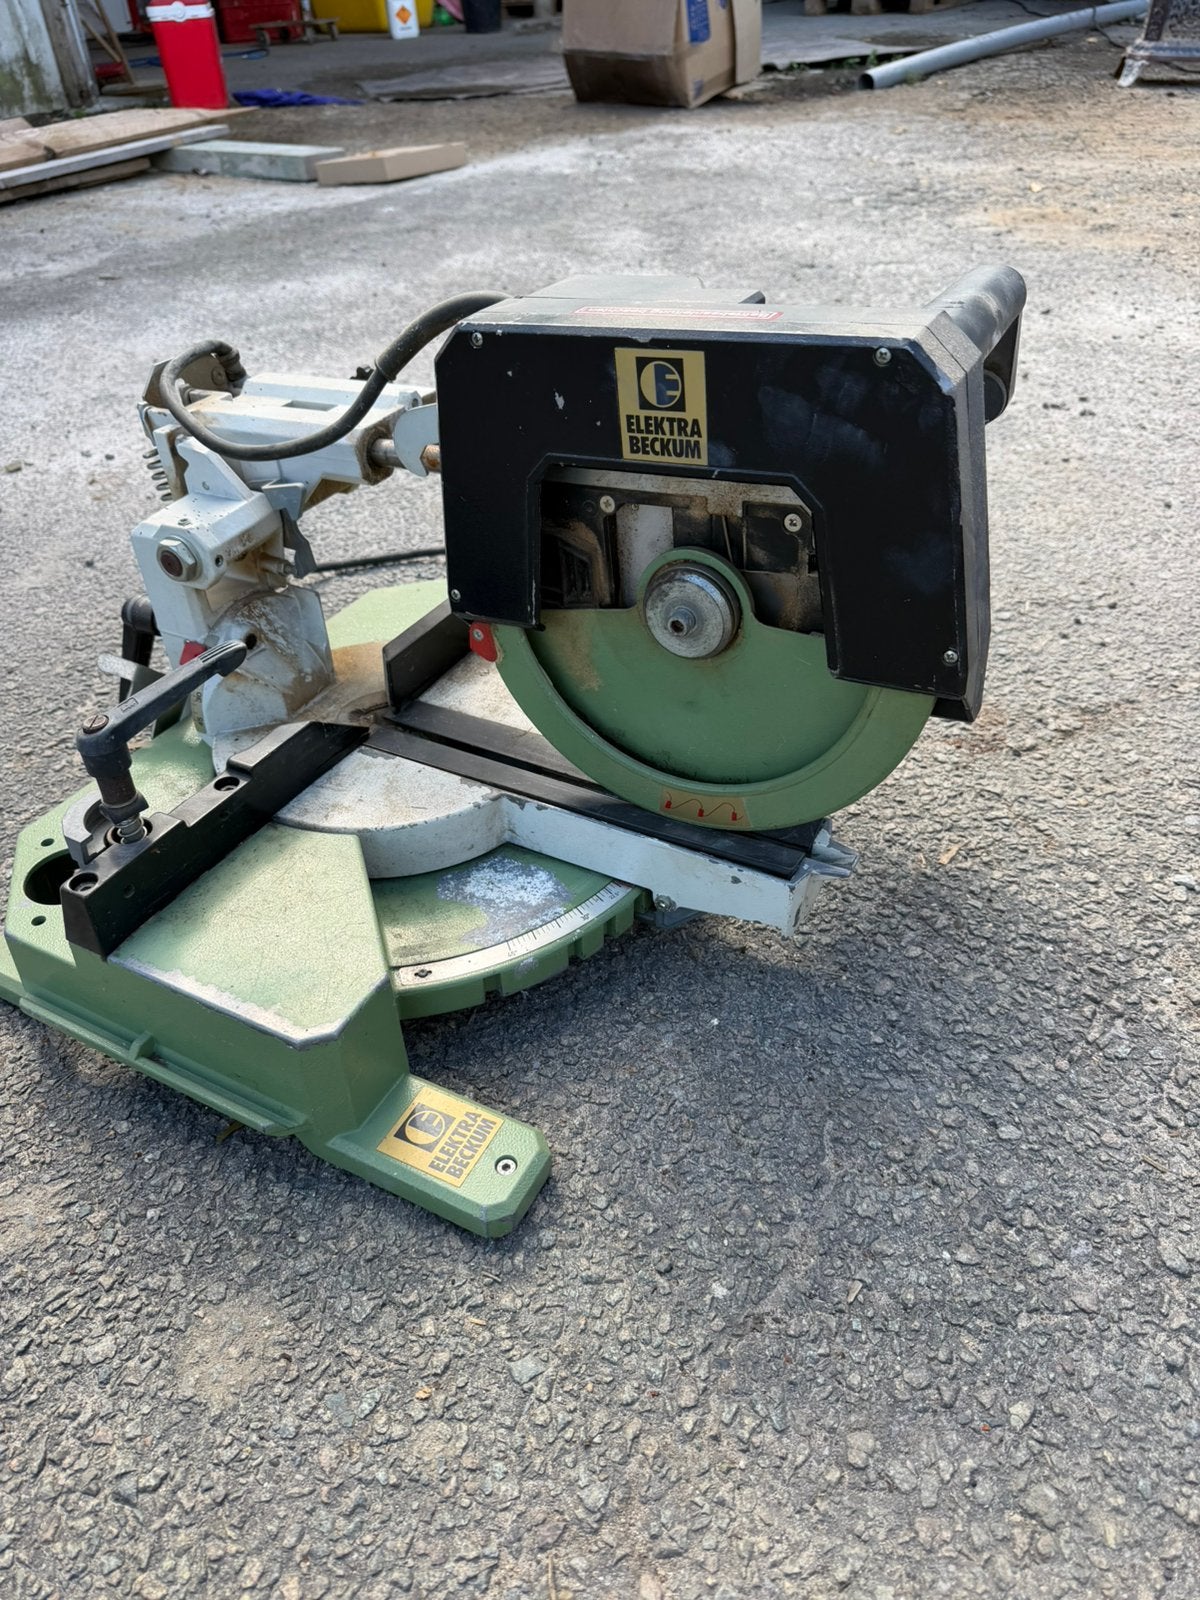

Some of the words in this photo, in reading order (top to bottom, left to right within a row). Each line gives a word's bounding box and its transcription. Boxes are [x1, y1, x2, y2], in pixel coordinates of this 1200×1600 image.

[626, 414, 703, 438] ELEKTRA
[628, 435, 702, 459] BECKUM
[428, 1111, 482, 1173] ELEKTRA
[446, 1117, 498, 1179] BECKUM
